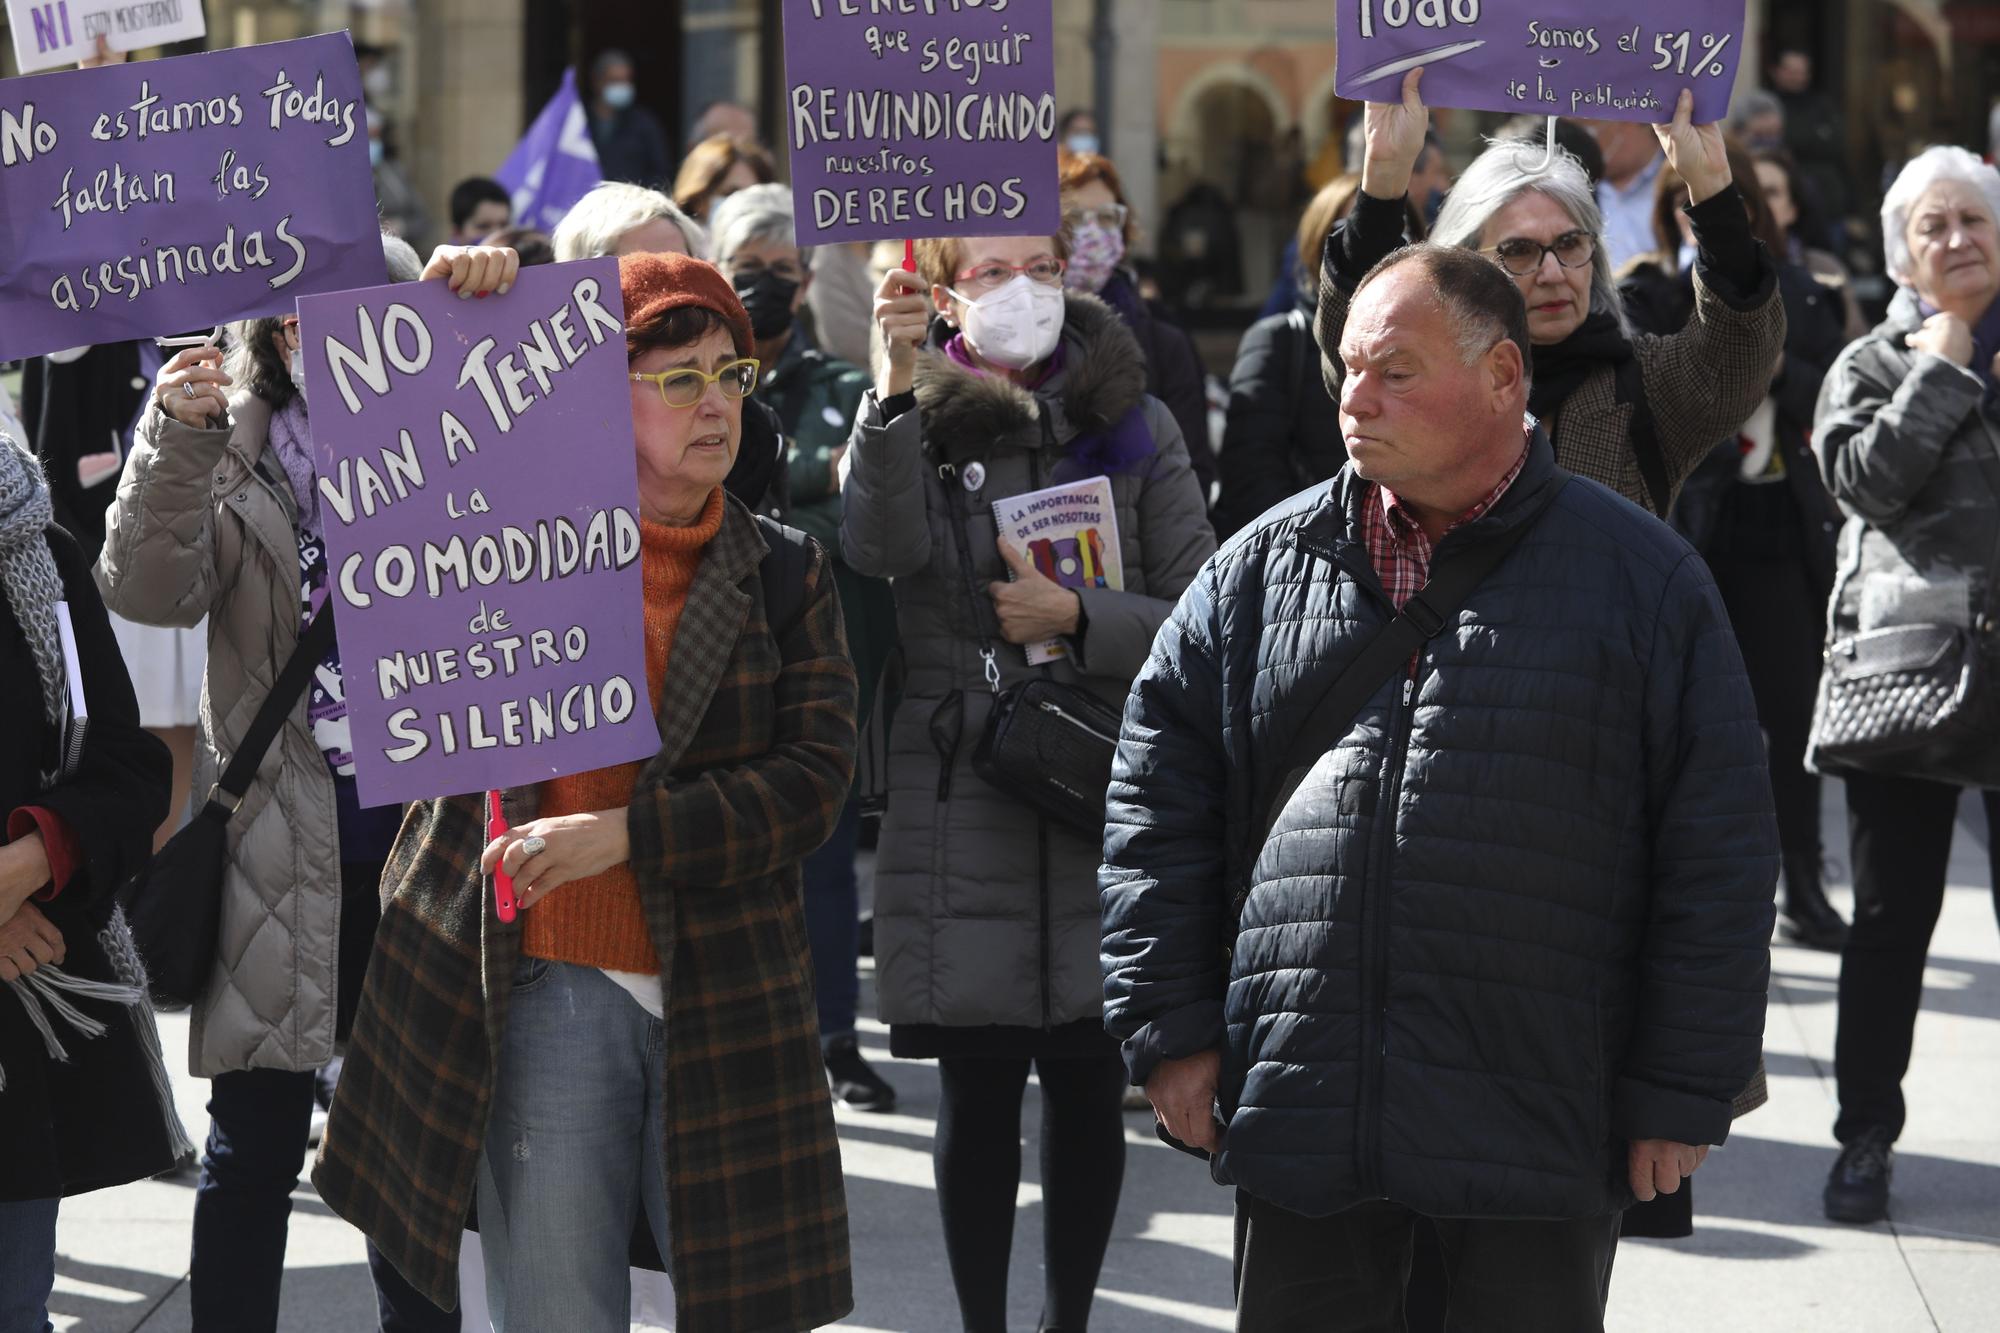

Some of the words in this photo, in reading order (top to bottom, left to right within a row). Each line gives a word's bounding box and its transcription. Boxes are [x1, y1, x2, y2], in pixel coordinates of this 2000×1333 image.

[31, 1, 73, 54] NI
[864, 26, 910, 59] que
[920, 24, 1032, 86] seguir
[1526, 20, 1600, 54] Somos
[1617, 25, 1640, 53] el
[1651, 30, 1732, 79] 51%
[1, 101, 58, 167] No
[91, 79, 244, 142] estamos
[791, 84, 1056, 150] REIVINDICANDO
[1505, 78, 1528, 100] de
[1537, 72, 1558, 104] la
[1571, 82, 1663, 113] población
[51, 161, 176, 232] faltan
[211, 148, 270, 202] las
[825, 146, 935, 176] nuestros
[813, 177, 1028, 230] DERECHOS
[51, 214, 307, 312] asesinadas
[324, 303, 433, 415] NO
[455, 277, 623, 434] TENER
[440, 410, 479, 467] A
[318, 428, 426, 526] VAN
[1010, 509, 1026, 523] LA
[1027, 494, 1100, 514] IMPORTANCIA
[1016, 526, 1031, 539] DE
[1032, 516, 1051, 532] SER
[1051, 511, 1102, 526] NOSOTRAS
[338, 506, 642, 609] COMODIDAD
[468, 600, 512, 635] de
[376, 624, 588, 701] NUESTRO
[383, 674, 636, 763] SILENCIO
